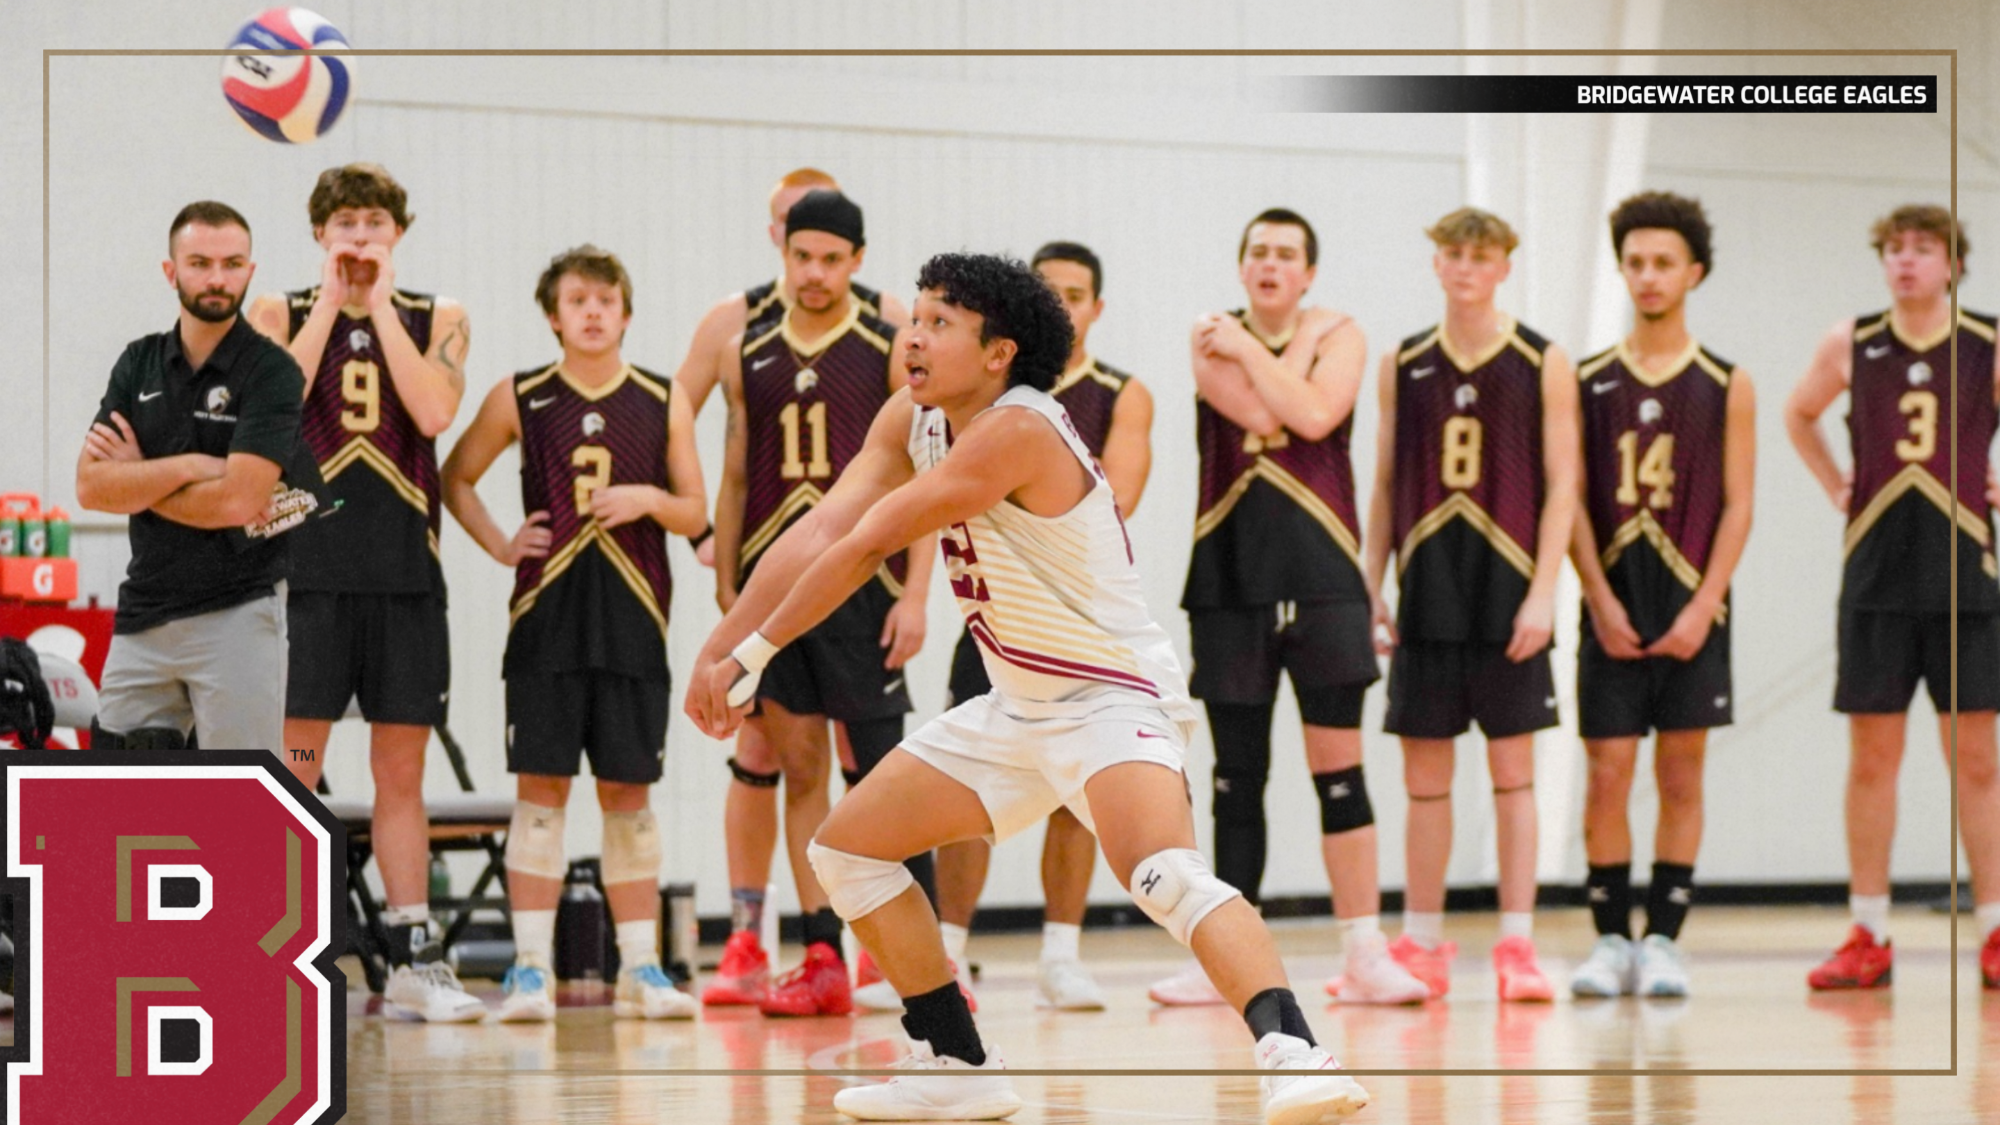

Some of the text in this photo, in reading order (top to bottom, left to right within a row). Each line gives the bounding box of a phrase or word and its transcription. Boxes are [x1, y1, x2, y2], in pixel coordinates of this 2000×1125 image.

[341, 360, 380, 432] 9
[1895, 391, 1938, 461] 3
[779, 401, 830, 478] 11
[1441, 416, 1483, 489] 8
[1615, 431, 1675, 509] 14
[571, 445, 612, 515] 2
[33, 563, 54, 597] G
[49, 677, 79, 699] TS
